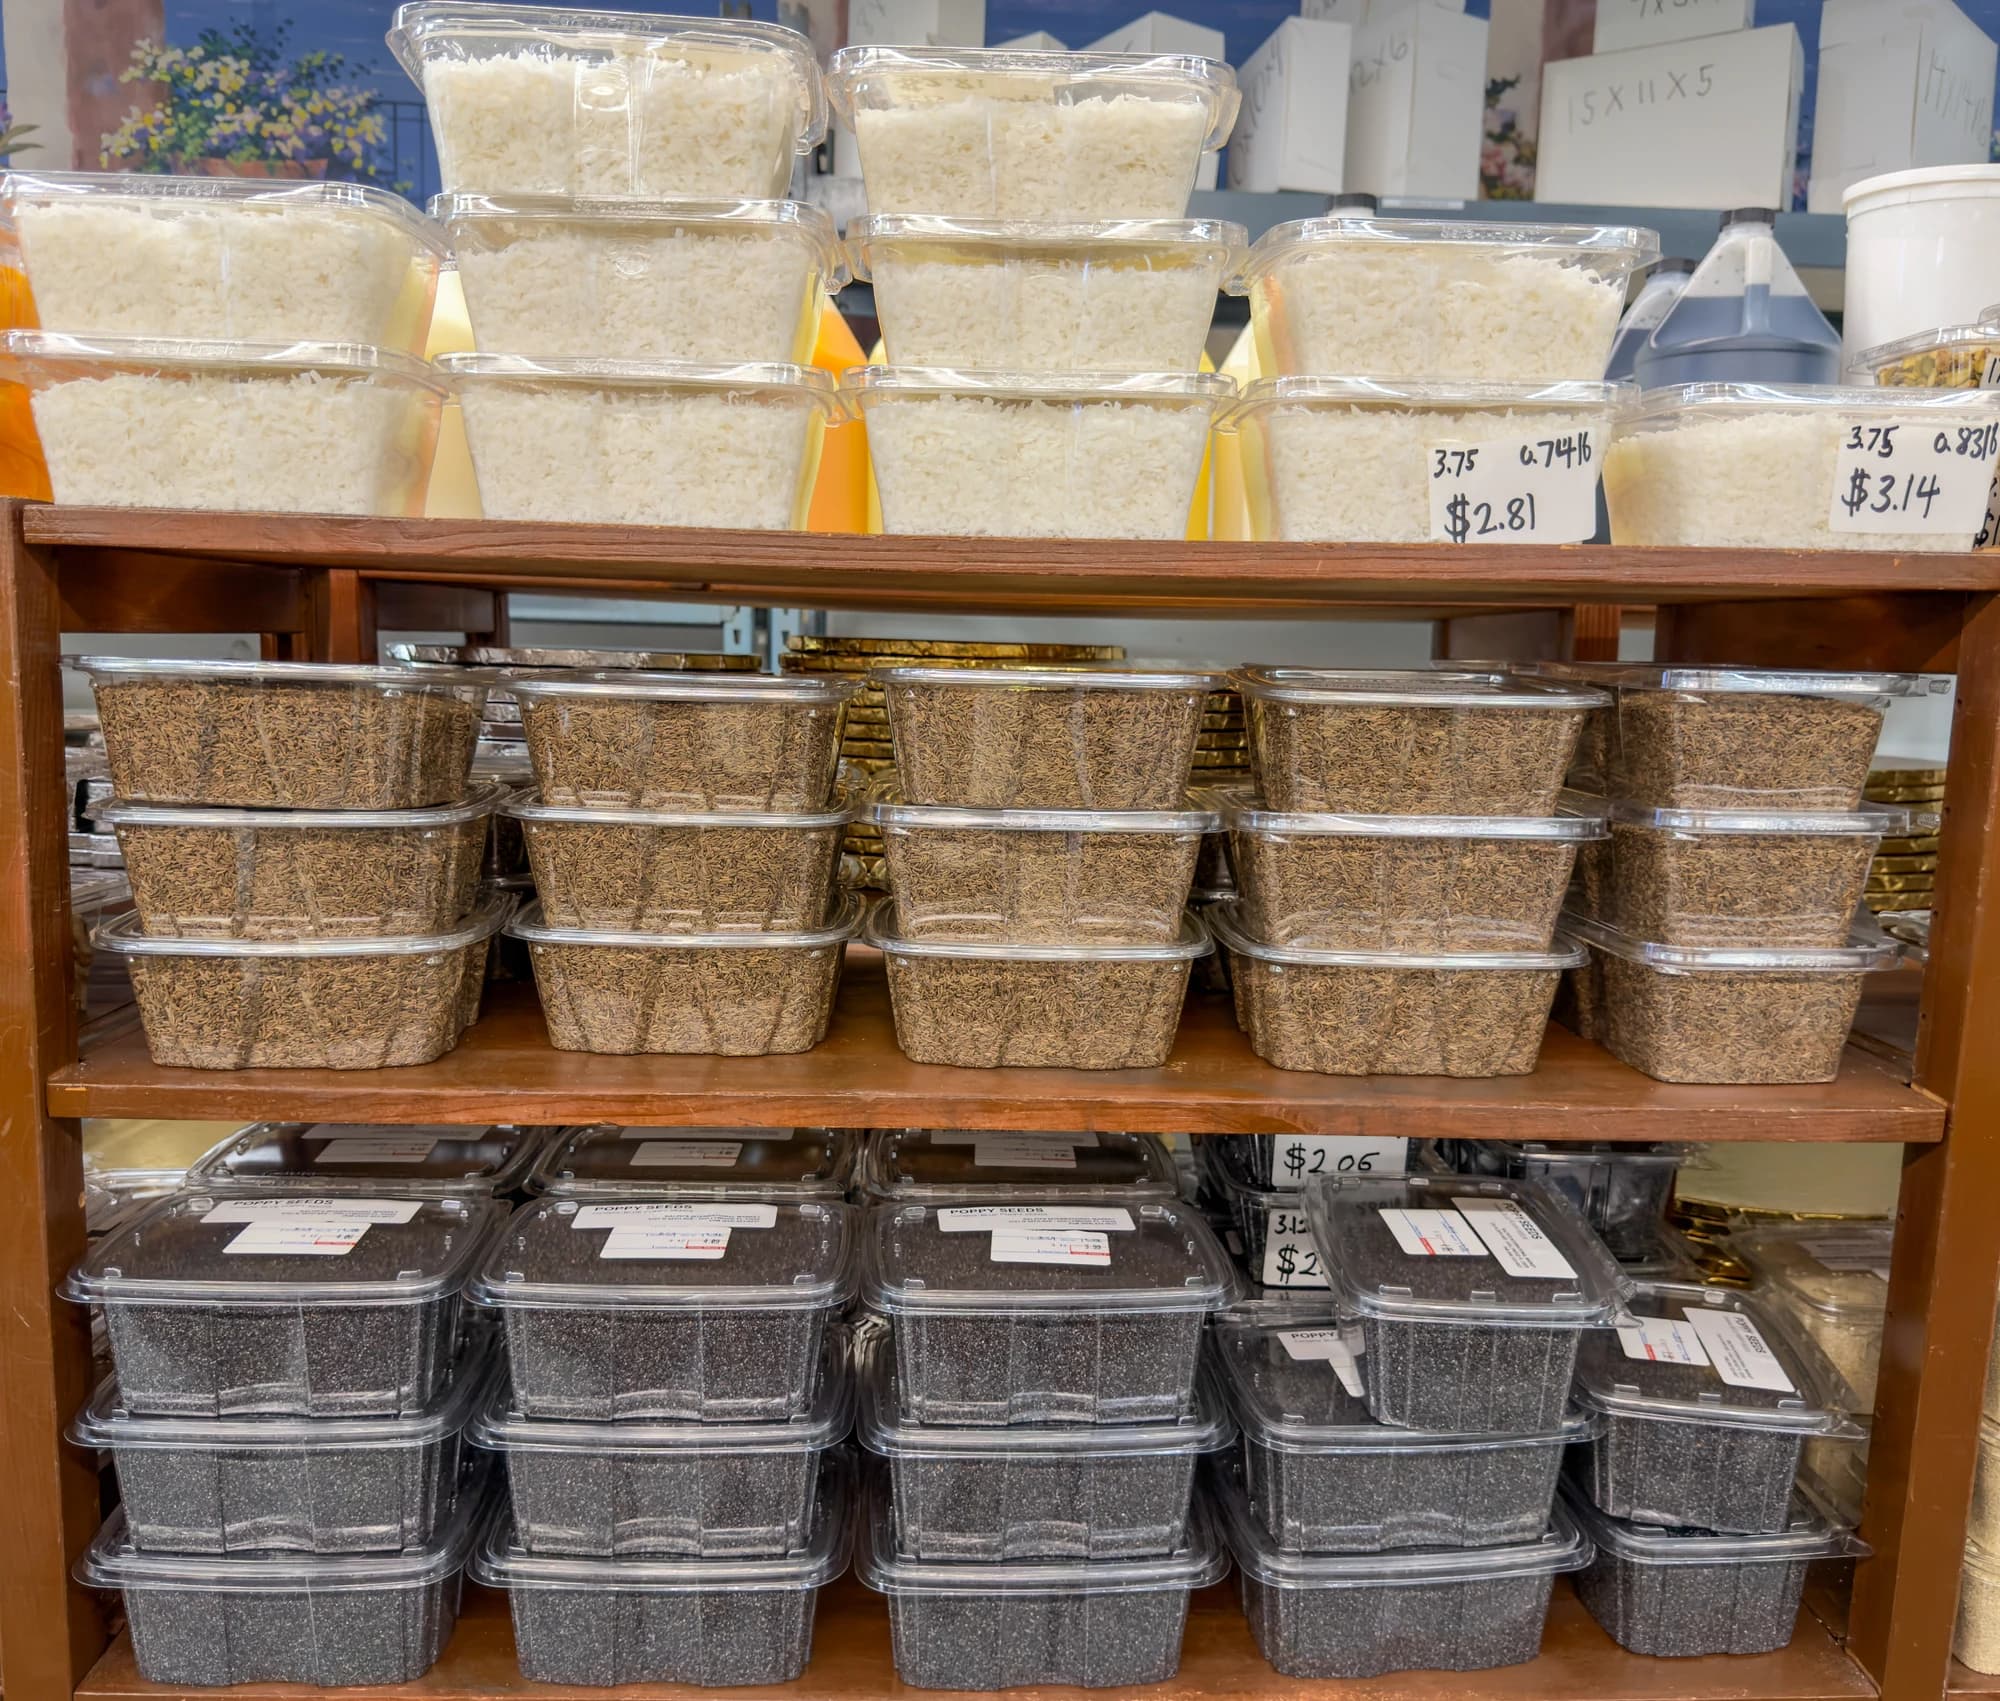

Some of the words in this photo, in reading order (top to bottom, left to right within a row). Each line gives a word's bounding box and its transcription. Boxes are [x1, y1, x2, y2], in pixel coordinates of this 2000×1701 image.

[1846, 424, 1900, 458] 3.75
[1433, 448, 1479, 479] 3.75
[1841, 466, 1941, 519] $3.14
[1444, 492, 1536, 544] $2.81
[1291, 1331, 1335, 1339] POPPY
